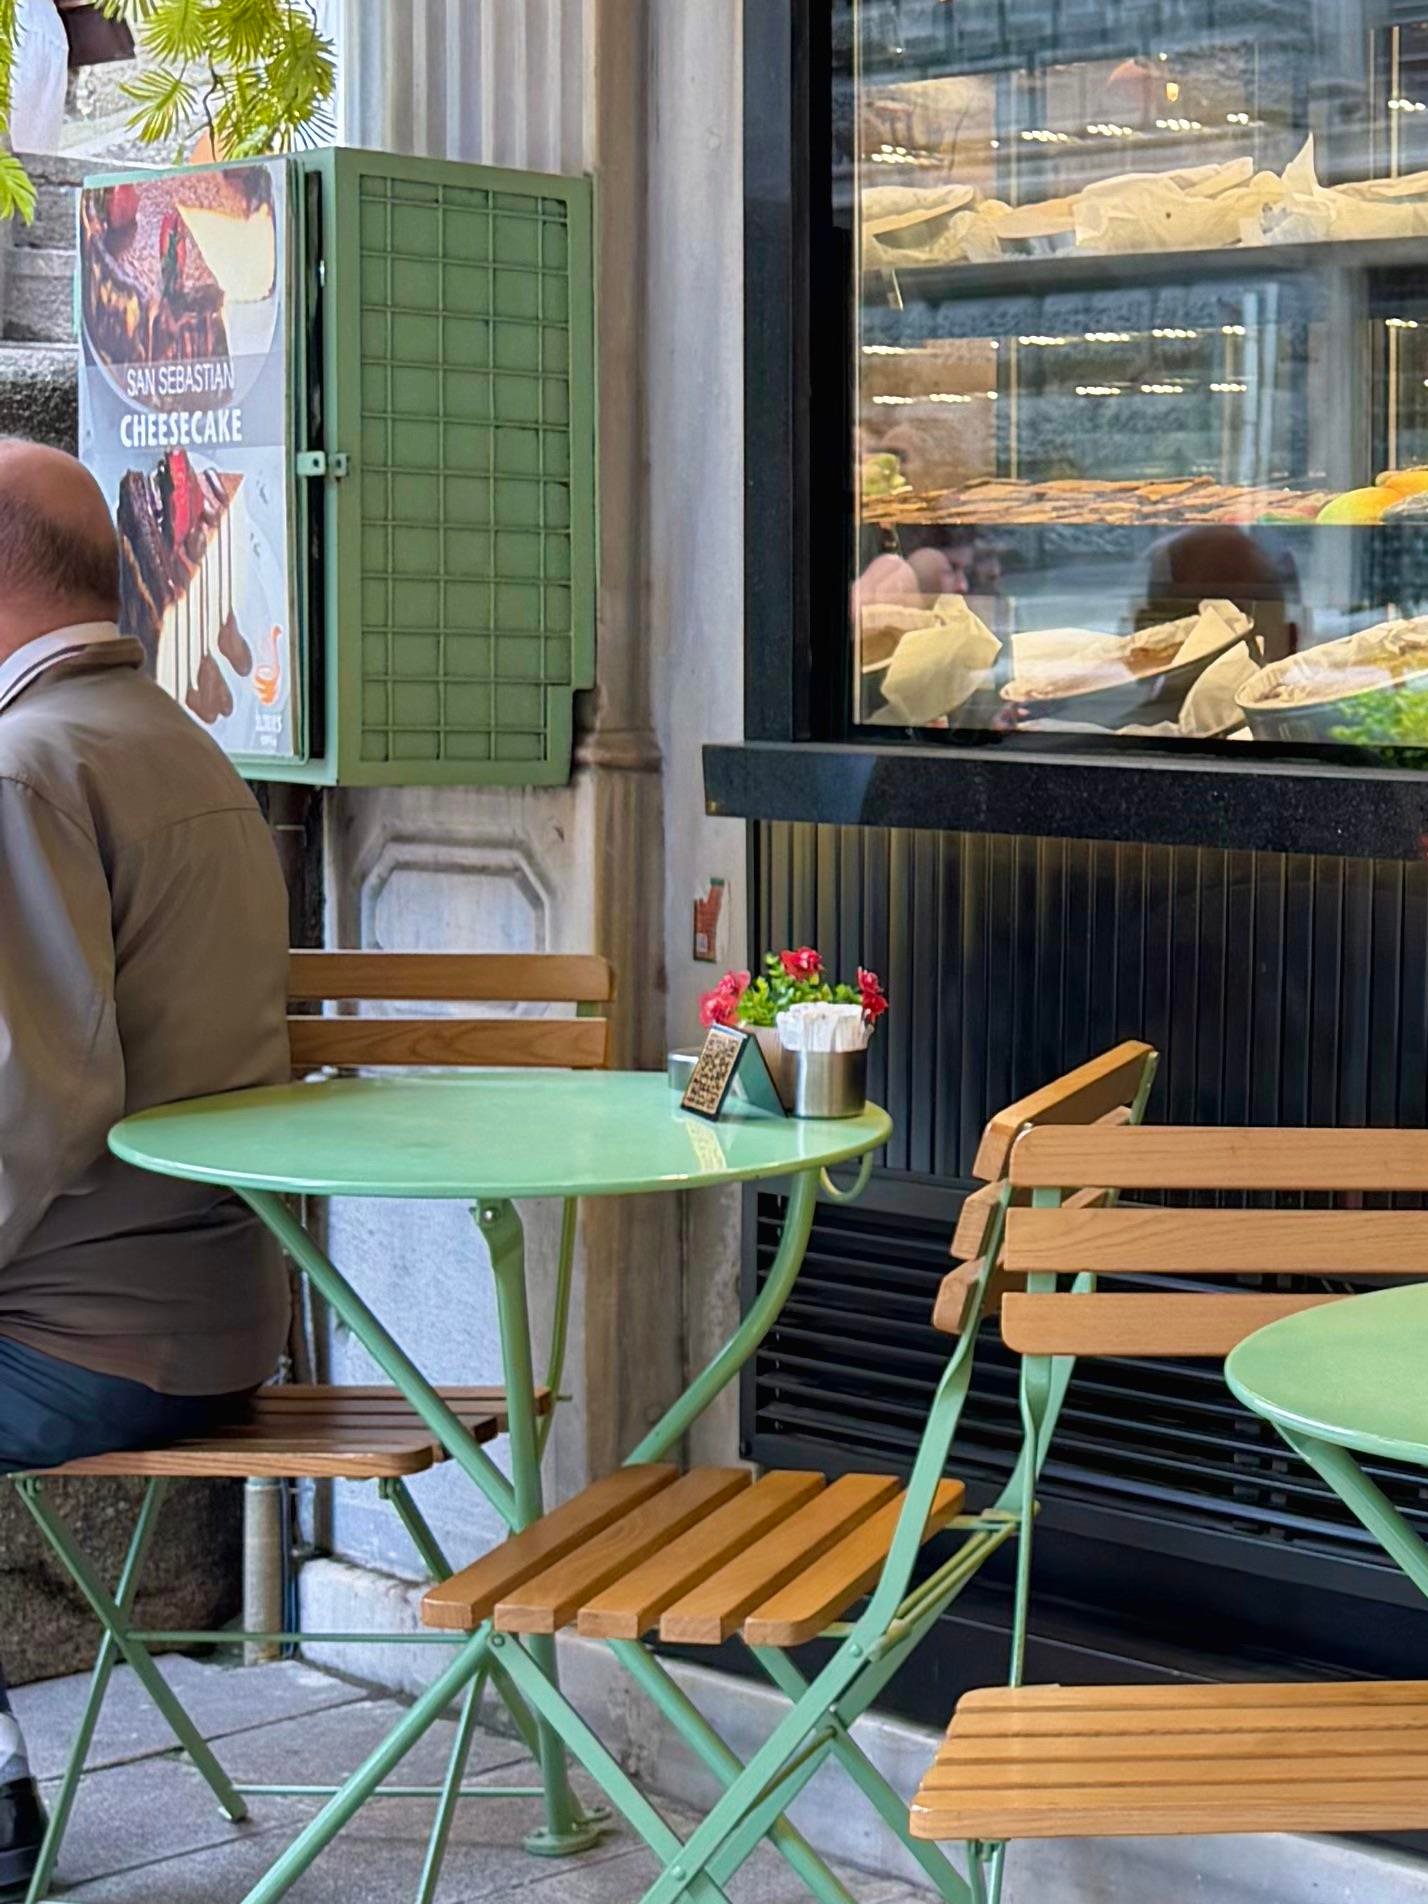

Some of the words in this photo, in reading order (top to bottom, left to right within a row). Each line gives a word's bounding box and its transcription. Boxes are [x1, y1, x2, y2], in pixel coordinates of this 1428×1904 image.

[126, 367, 156, 397] SAN
[158, 361, 235, 396] SEBASTIAN
[119, 408, 243, 448] CHEESECAKE
